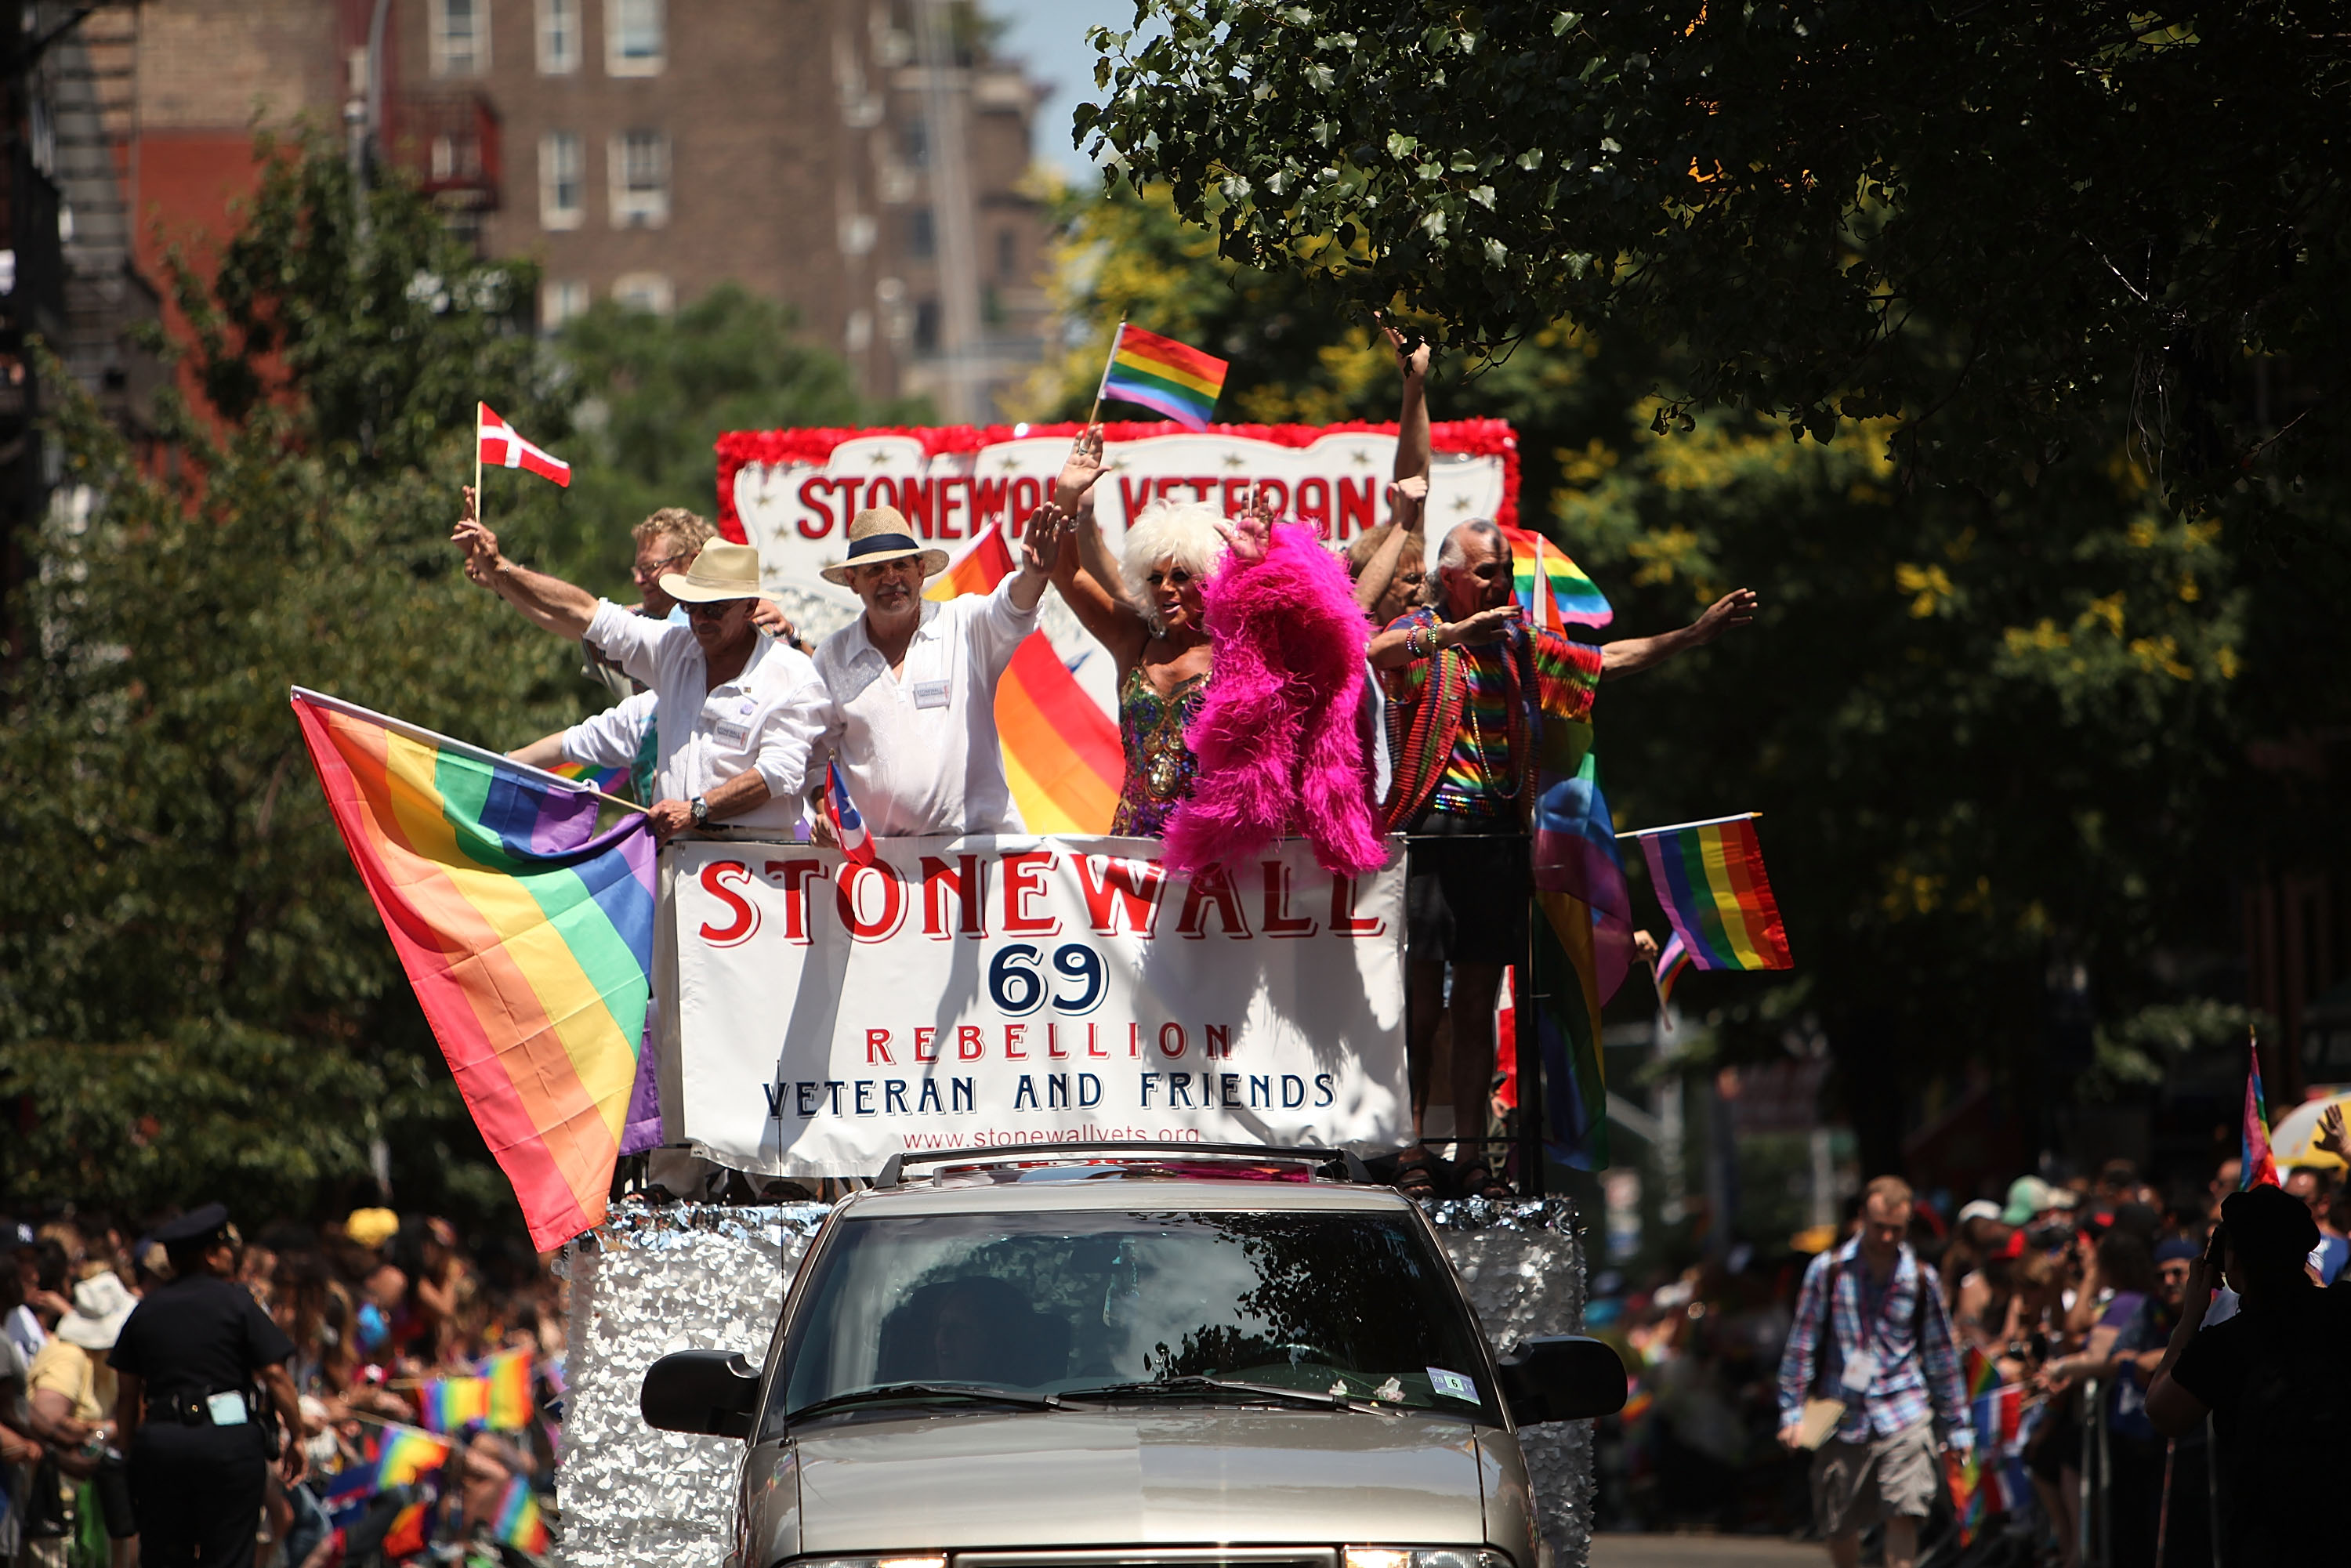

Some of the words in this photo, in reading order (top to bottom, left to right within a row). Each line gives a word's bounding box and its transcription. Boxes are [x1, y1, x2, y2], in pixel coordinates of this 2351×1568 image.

[796, 476, 1103, 540] STONEWA
[1119, 476, 1396, 542] VTERAN
[698, 851, 1386, 948] STONEWALL
[987, 943, 1110, 1017] 69
[864, 1021, 1232, 1066] REBELLION
[761, 1076, 977, 1120] VETERAN
[1012, 1074, 1104, 1113] AND
[1139, 1071, 1337, 1112] FRIENDS
[902, 1123, 1200, 1149] www.stonewallvetsorg
[1451, 1378, 1458, 1388] 6
